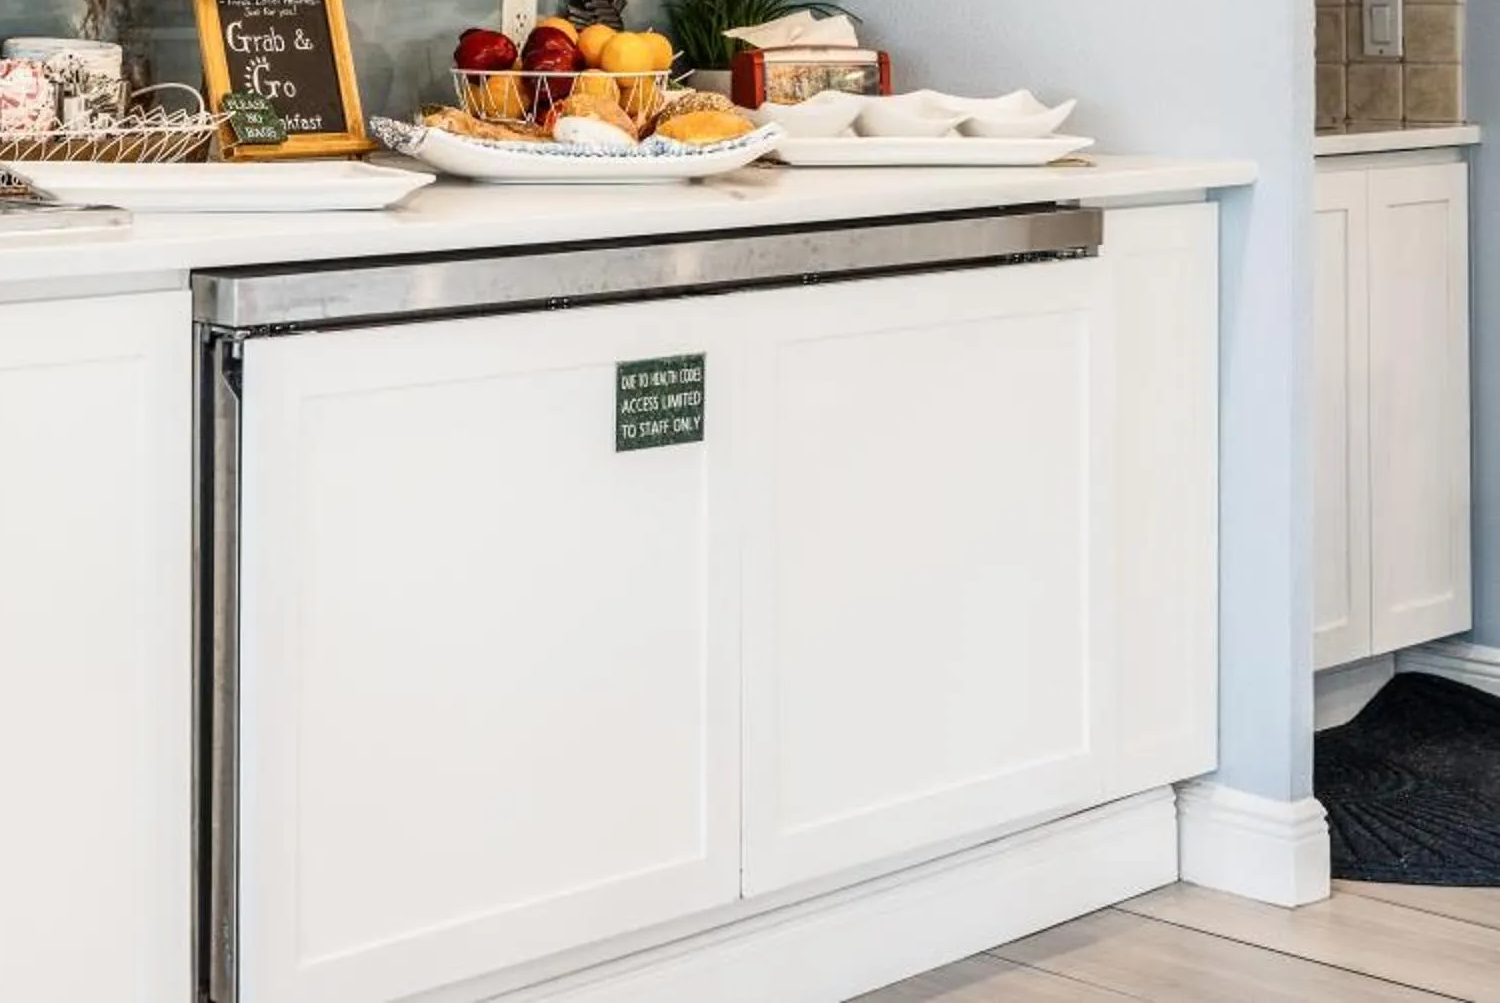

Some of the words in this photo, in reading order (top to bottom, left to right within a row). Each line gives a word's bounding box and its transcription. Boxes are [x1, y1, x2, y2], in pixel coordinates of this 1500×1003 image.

[226, 20, 285, 53] Grab
[294, 28, 315, 50] &
[253, 62, 297, 99] Go
[621, 396, 659, 414] ACCESS
[661, 391, 701, 410] LIMITED
[621, 423, 637, 439] TO
[639, 419, 669, 438] STAFF
[673, 415, 701, 433] ONLY
